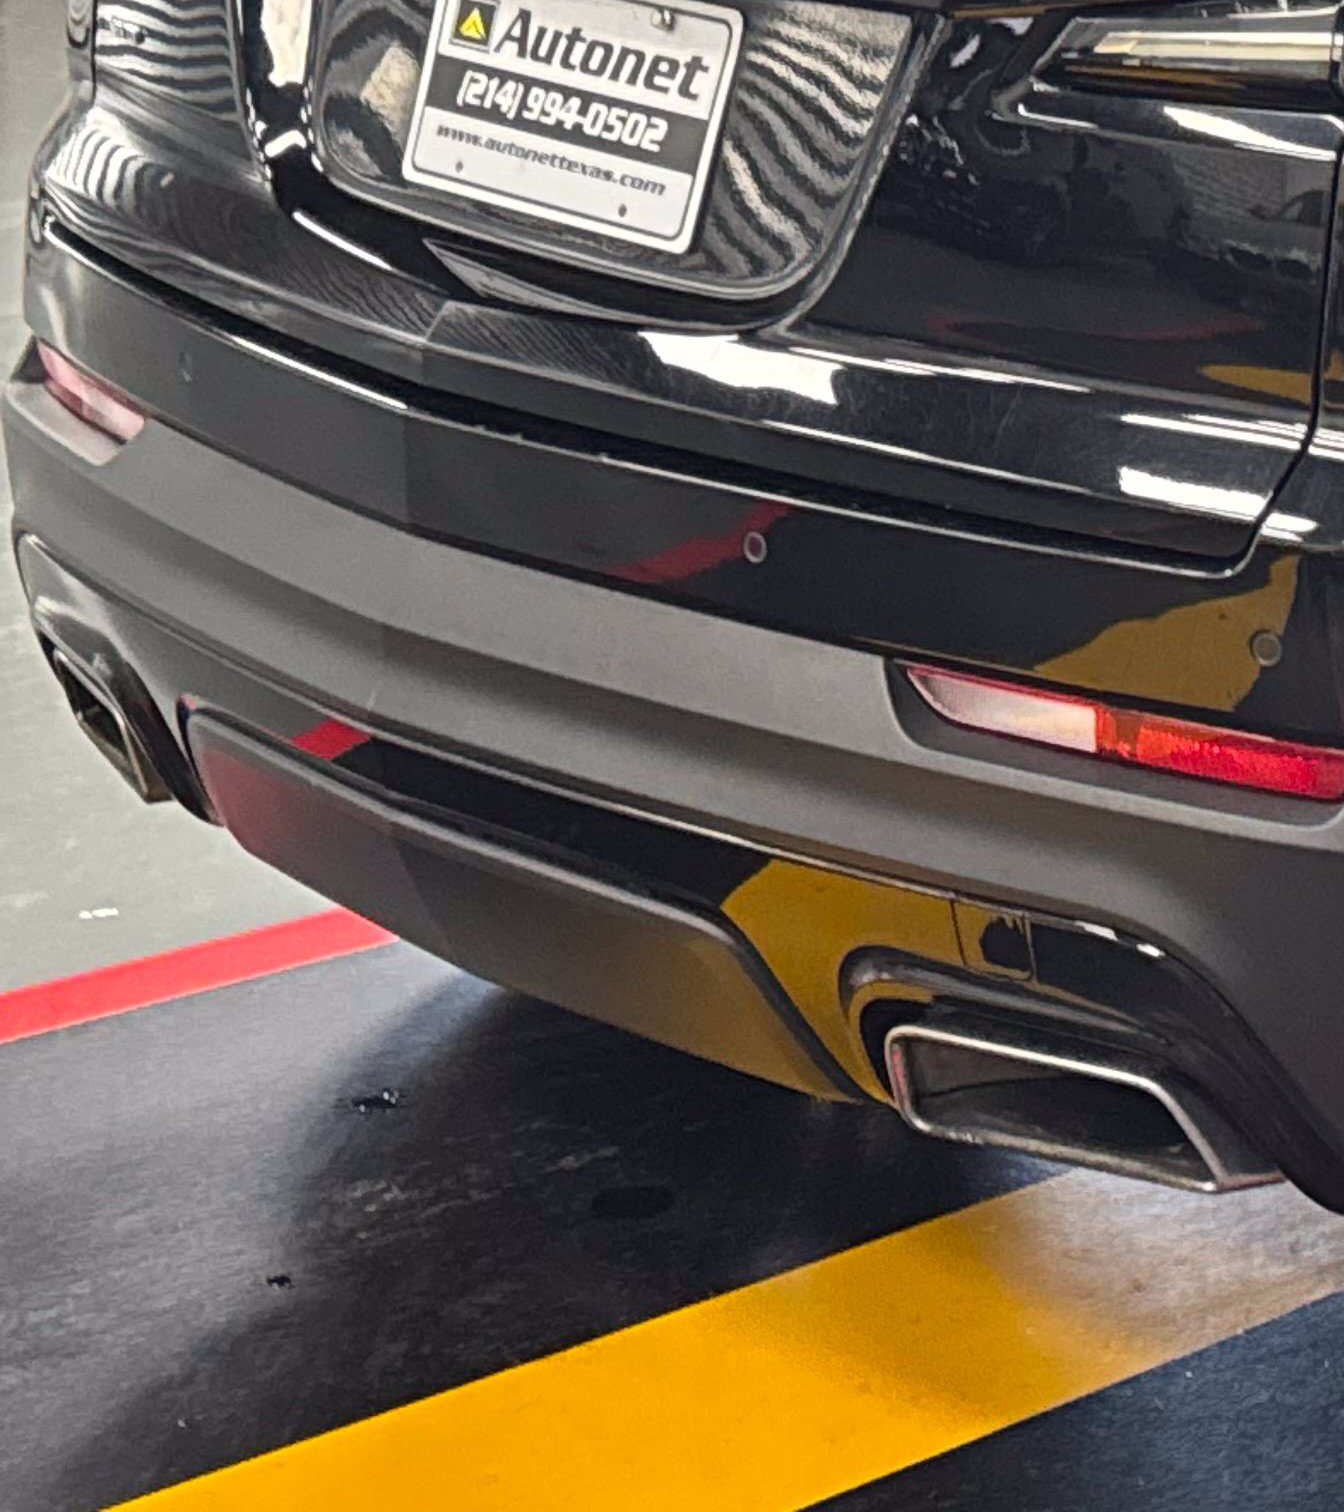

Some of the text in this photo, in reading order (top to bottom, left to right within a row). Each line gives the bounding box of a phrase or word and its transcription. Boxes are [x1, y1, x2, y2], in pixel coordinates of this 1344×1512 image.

[493, 7, 710, 101] Autonet
[456, 69, 669, 154] (214) 994-0502
[435, 123, 667, 197] www.autonettexas.com
